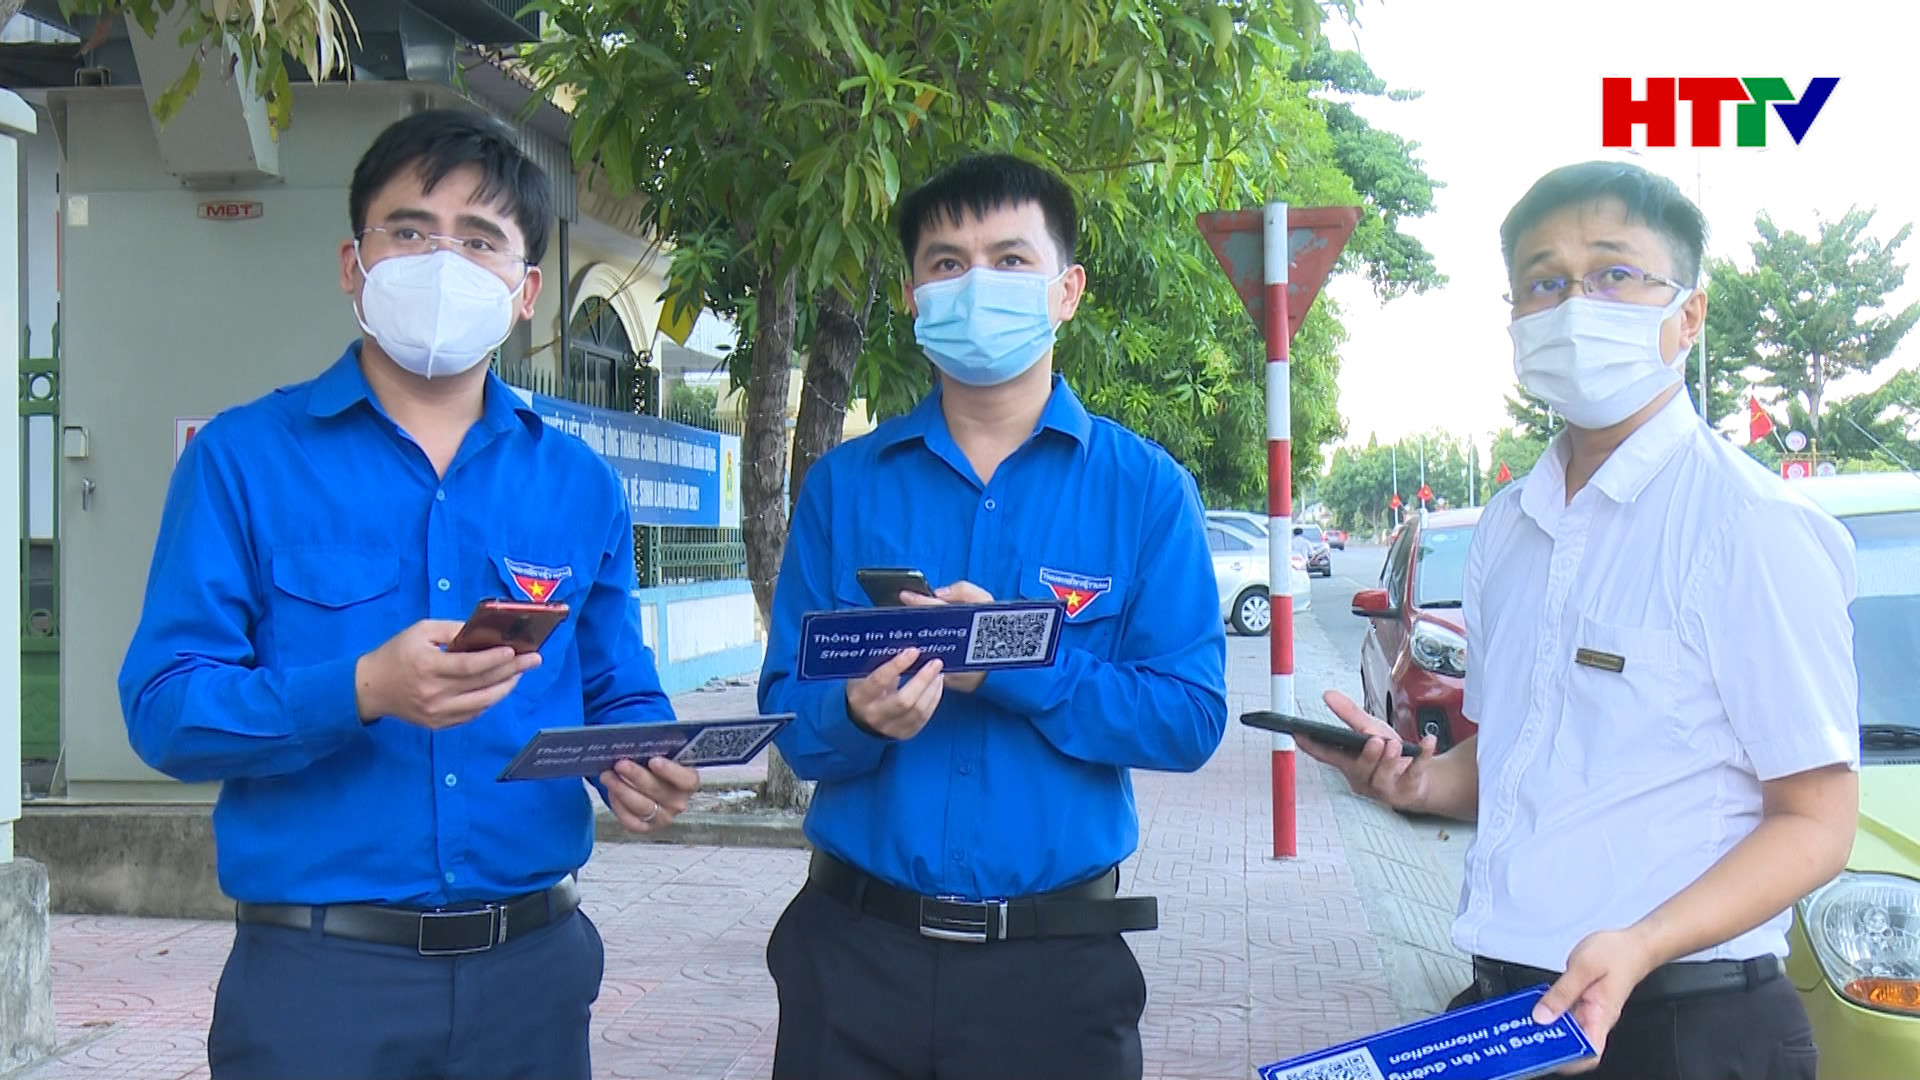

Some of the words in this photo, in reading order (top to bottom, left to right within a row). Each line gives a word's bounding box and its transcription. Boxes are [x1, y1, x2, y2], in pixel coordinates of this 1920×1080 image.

[206, 203, 253, 217] MBT
[813, 632, 861, 643] Thông
[865, 631, 884, 641] tin
[889, 629, 913, 639] tên
[917, 628, 968, 638] đường
[820, 647, 865, 659] Street
[868, 643, 957, 657] inforation
[1493, 1016, 1533, 1036] treet
[1509, 1026, 1567, 1049] Thông
[1389, 1028, 1489, 1065] information
[1483, 1043, 1508, 1057] tin
[1450, 1051, 1481, 1066] tên
